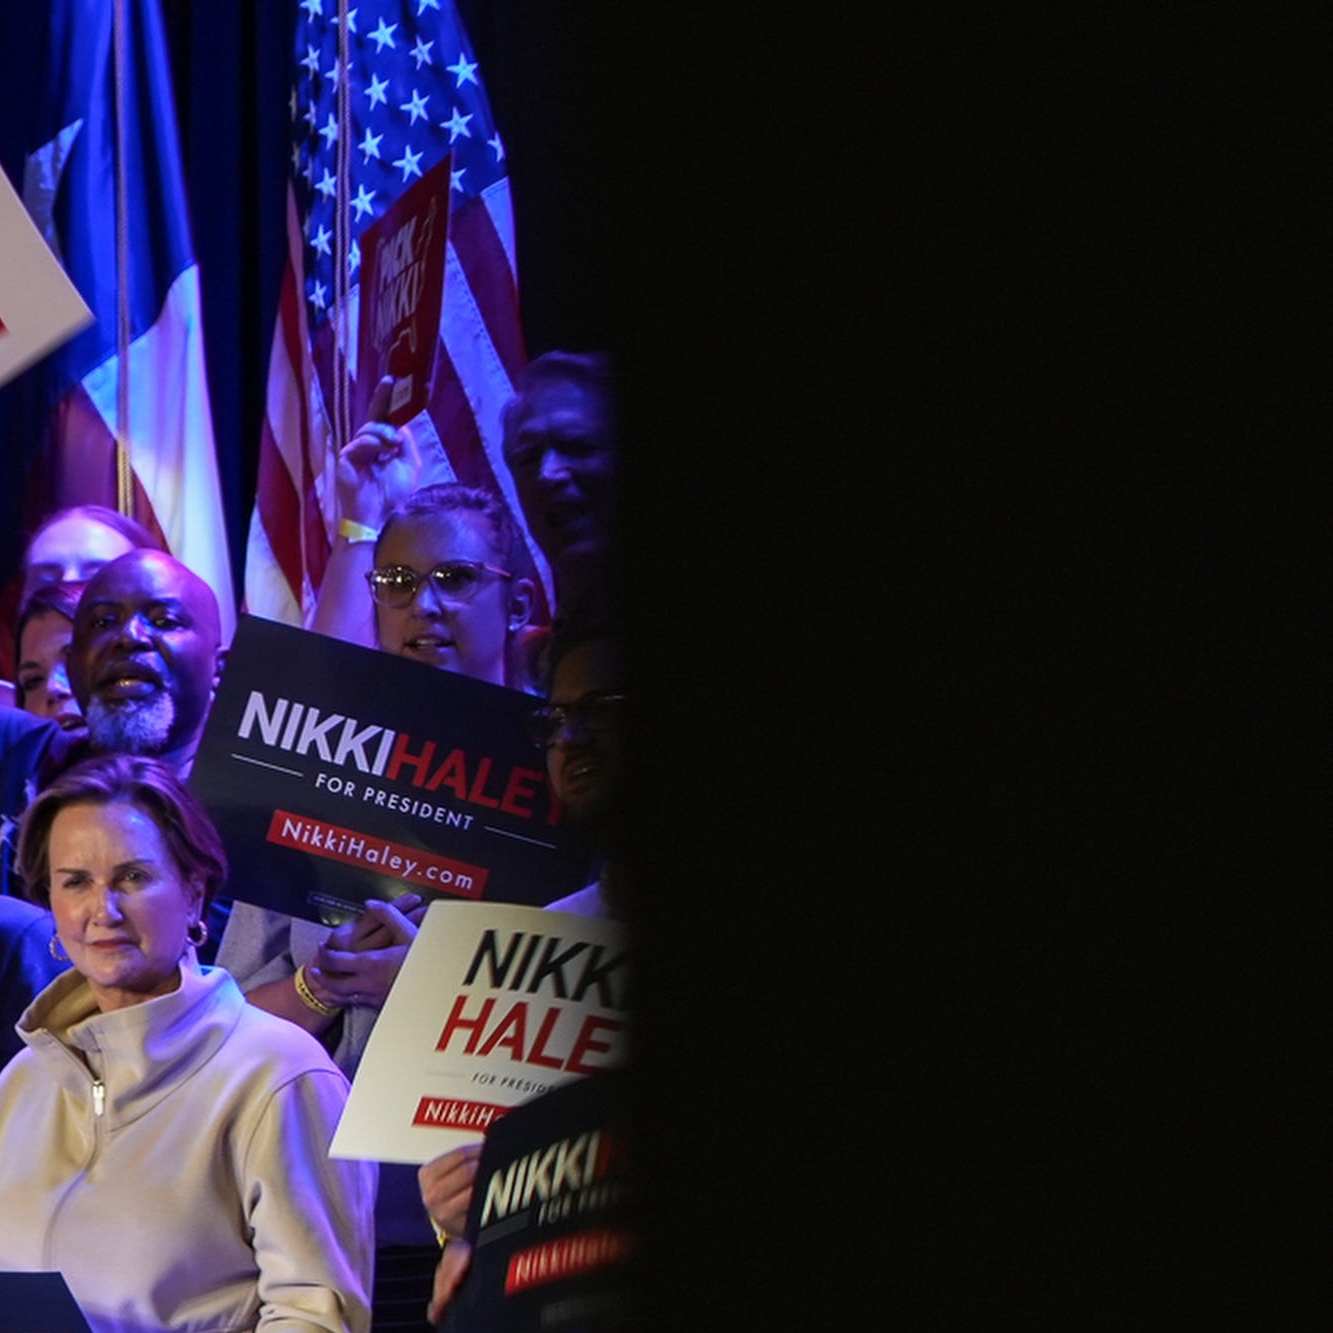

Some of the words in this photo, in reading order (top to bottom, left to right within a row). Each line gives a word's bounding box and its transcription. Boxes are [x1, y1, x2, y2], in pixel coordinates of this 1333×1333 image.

[314, 773, 355, 798] FOR
[362, 786, 475, 831] PRESIDENT
[281, 818, 474, 890] NikkiHaley.com
[471, 1072, 496, 1086] FOR
